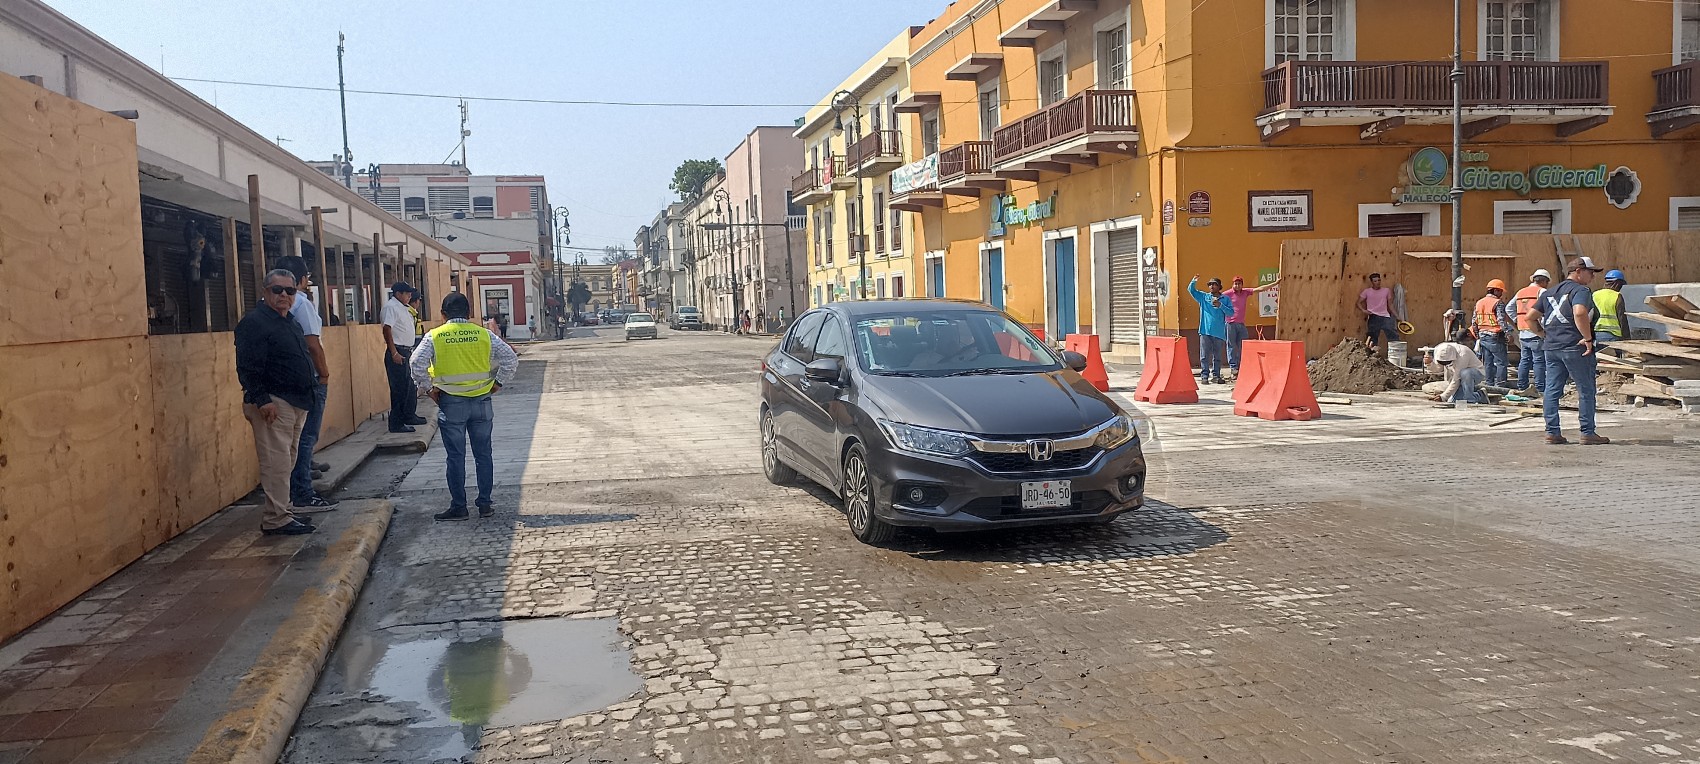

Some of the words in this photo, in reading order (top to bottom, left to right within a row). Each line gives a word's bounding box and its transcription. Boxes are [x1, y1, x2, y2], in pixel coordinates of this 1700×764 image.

[1461, 167, 1530, 194] Güero,
[1536, 164, 1606, 187] Güera!
[1023, 487, 1070, 502] JRD-46-50
